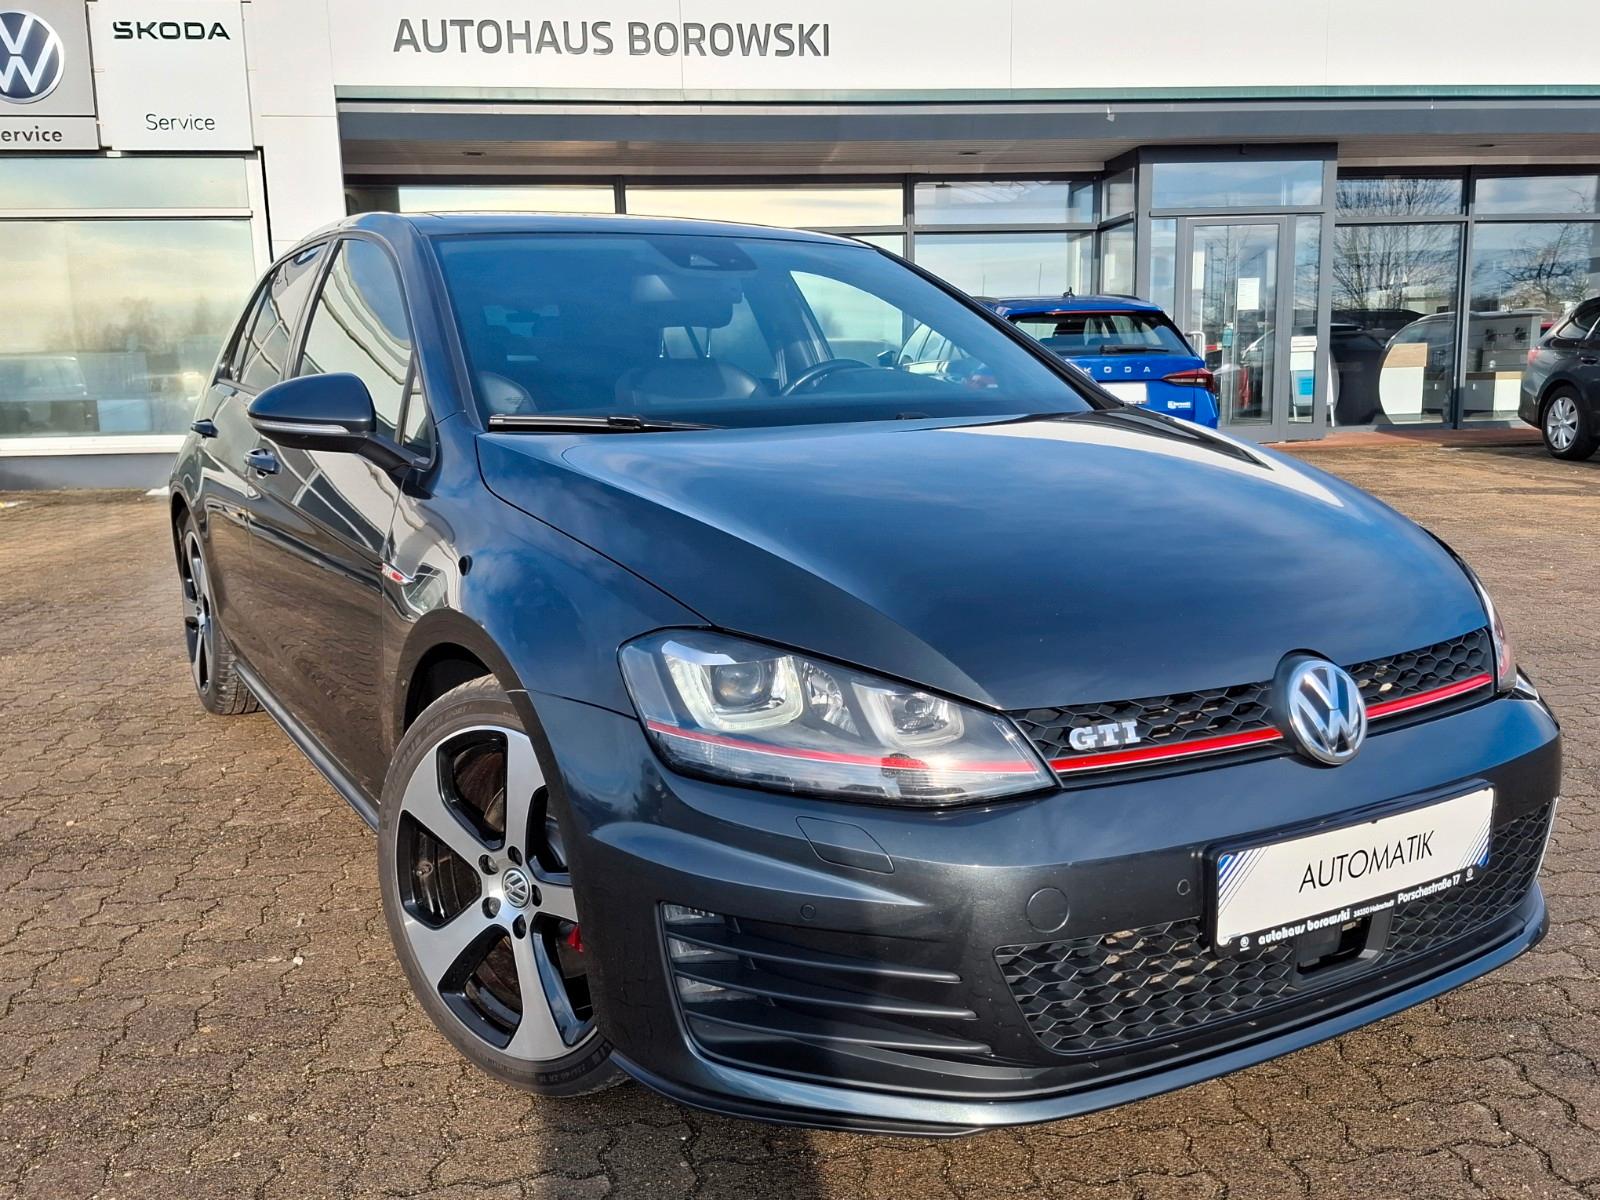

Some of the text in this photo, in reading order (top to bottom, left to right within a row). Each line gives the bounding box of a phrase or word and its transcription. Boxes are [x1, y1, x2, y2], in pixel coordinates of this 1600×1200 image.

[393, 18, 830, 57] AUTOHAUS BOROWSKI
[0, 125, 62, 142] ervice
[145, 112, 215, 131] Service
[1069, 718, 1141, 750] GTI
[1298, 830, 1435, 893] AUTOMATIK
[1258, 924, 1306, 944] autohaus
[1307, 908, 1350, 931] borowski
[1397, 877, 1452, 905] Porschestraße
[1452, 873, 1461, 886] 17
